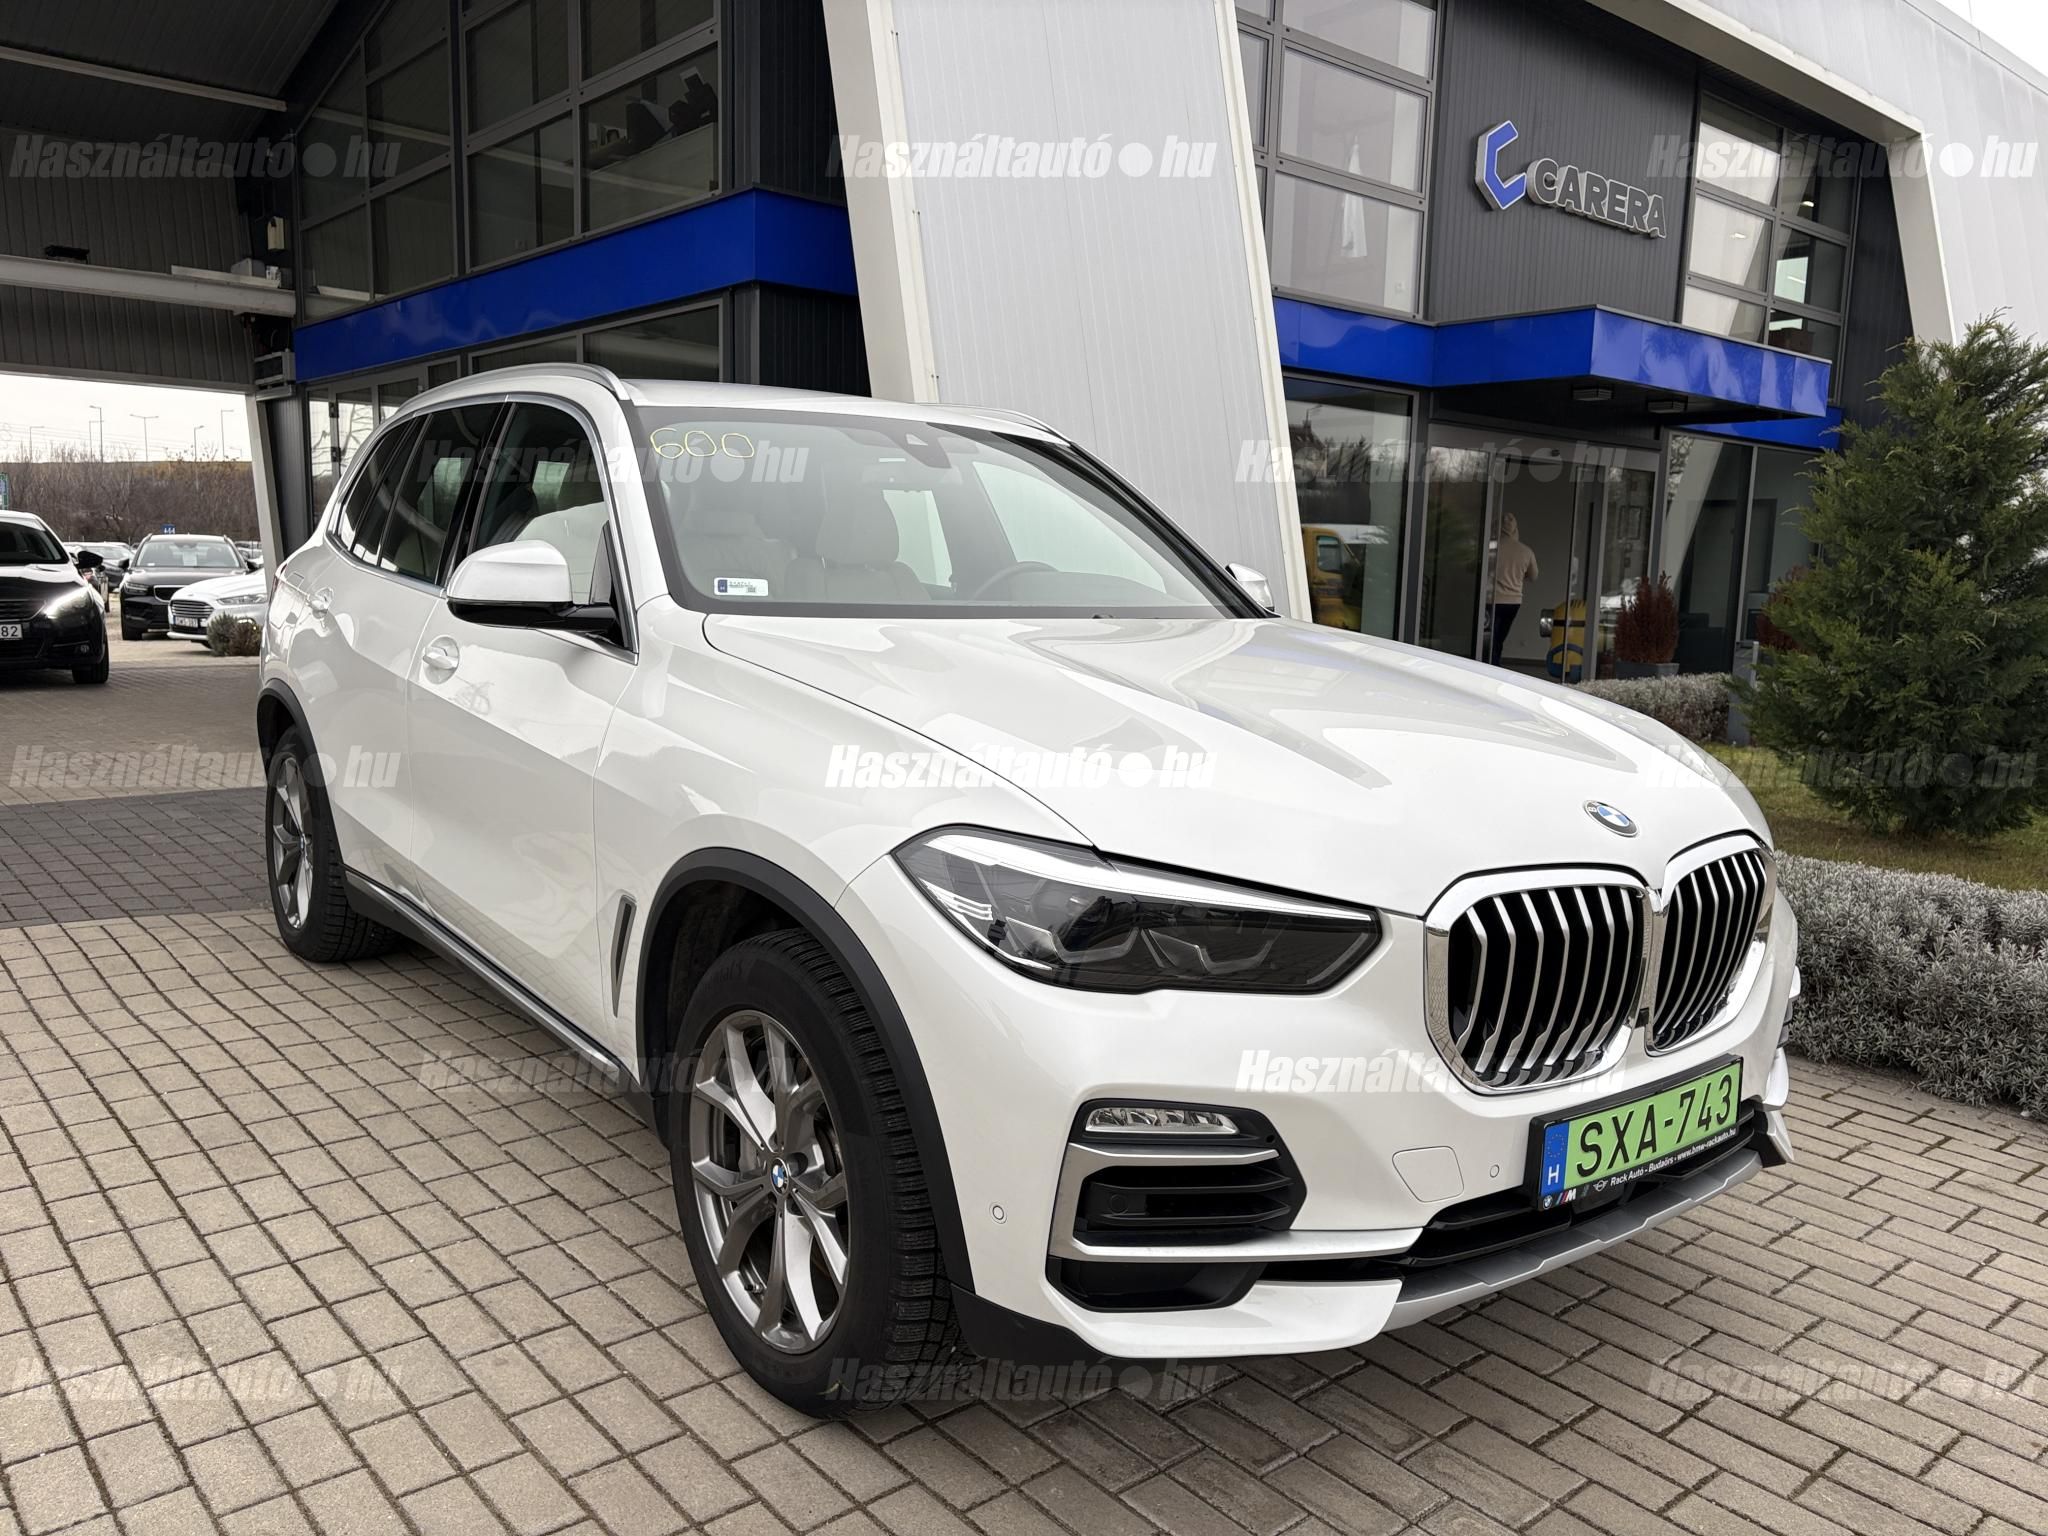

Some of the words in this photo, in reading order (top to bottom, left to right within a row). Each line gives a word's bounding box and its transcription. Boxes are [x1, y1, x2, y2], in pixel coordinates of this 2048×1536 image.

[1528, 158, 1666, 239] CARERA
[650, 427, 755, 460] 600
[1576, 1074, 1733, 1178] SXA-743
[1547, 1163, 1560, 1186] H
[1610, 1173, 1628, 1187] Rack
